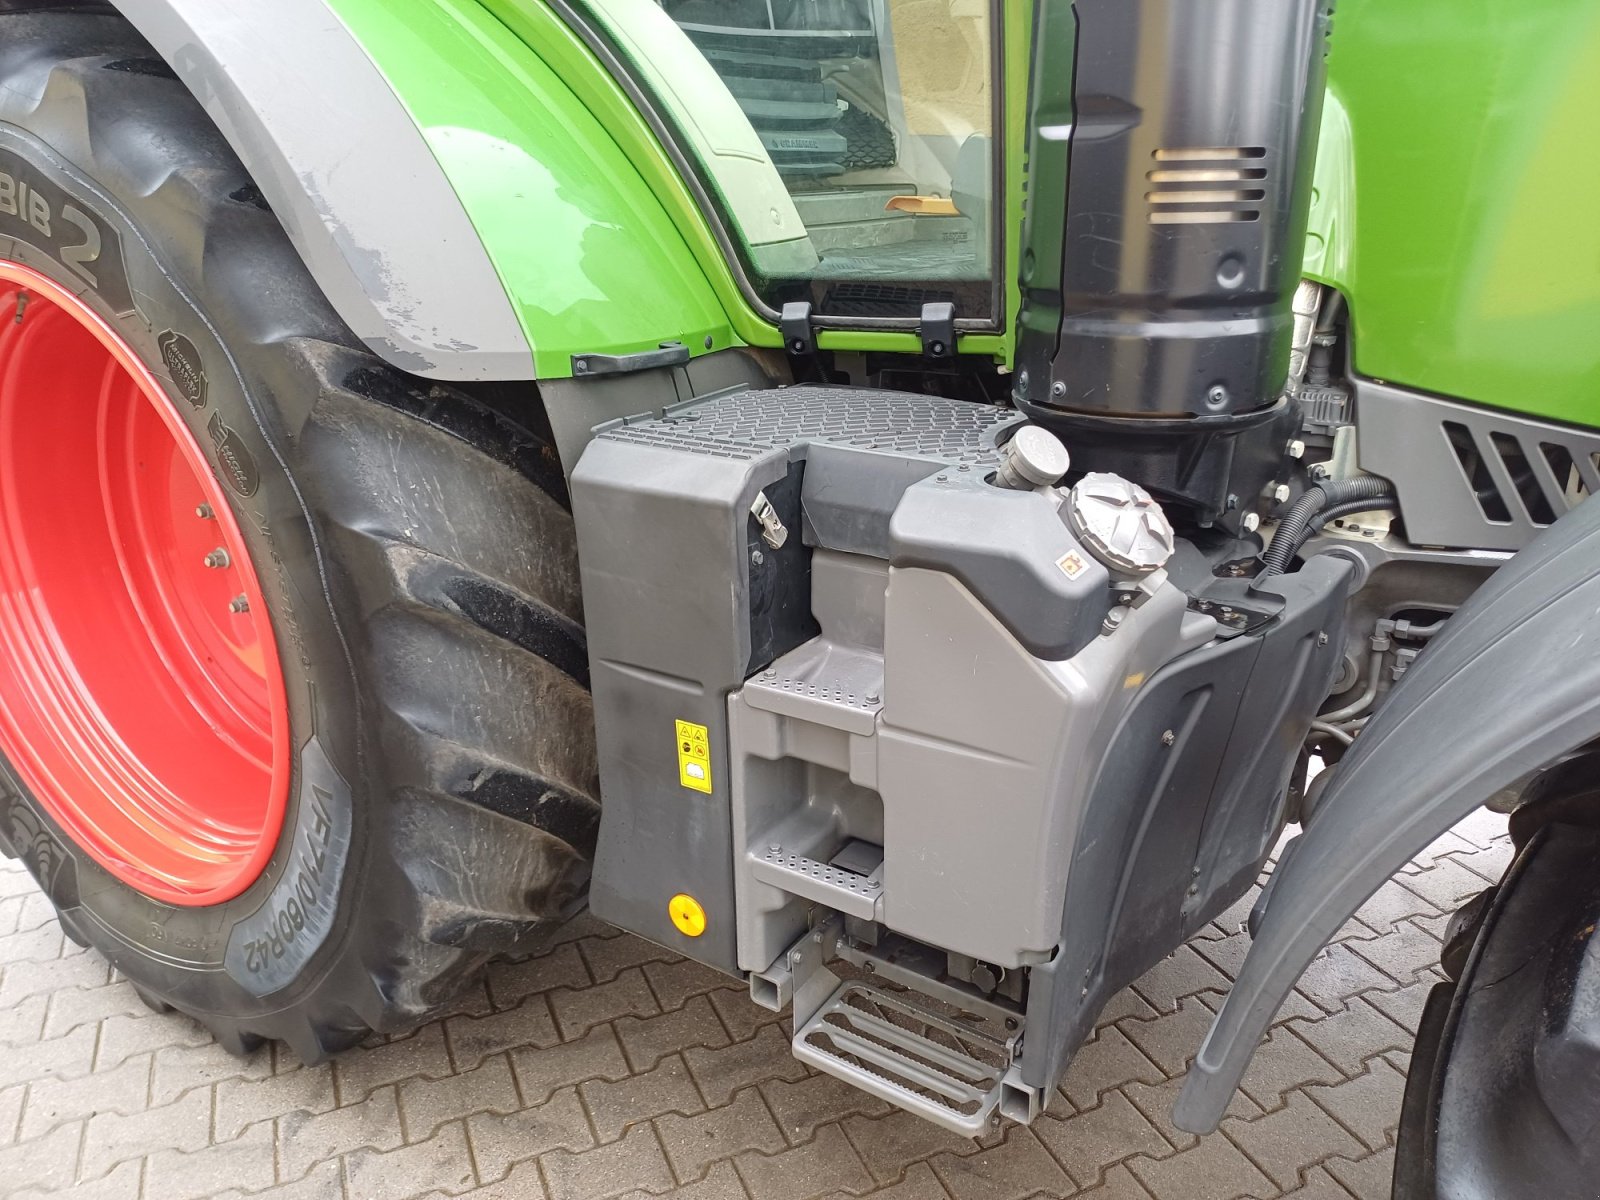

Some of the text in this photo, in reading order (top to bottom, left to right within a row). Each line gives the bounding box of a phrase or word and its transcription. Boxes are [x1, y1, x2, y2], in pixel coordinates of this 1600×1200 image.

[60, 204, 101, 289] 2
[168, 343, 200, 383] MICHELIN
[222, 444, 248, 481] HIGH
